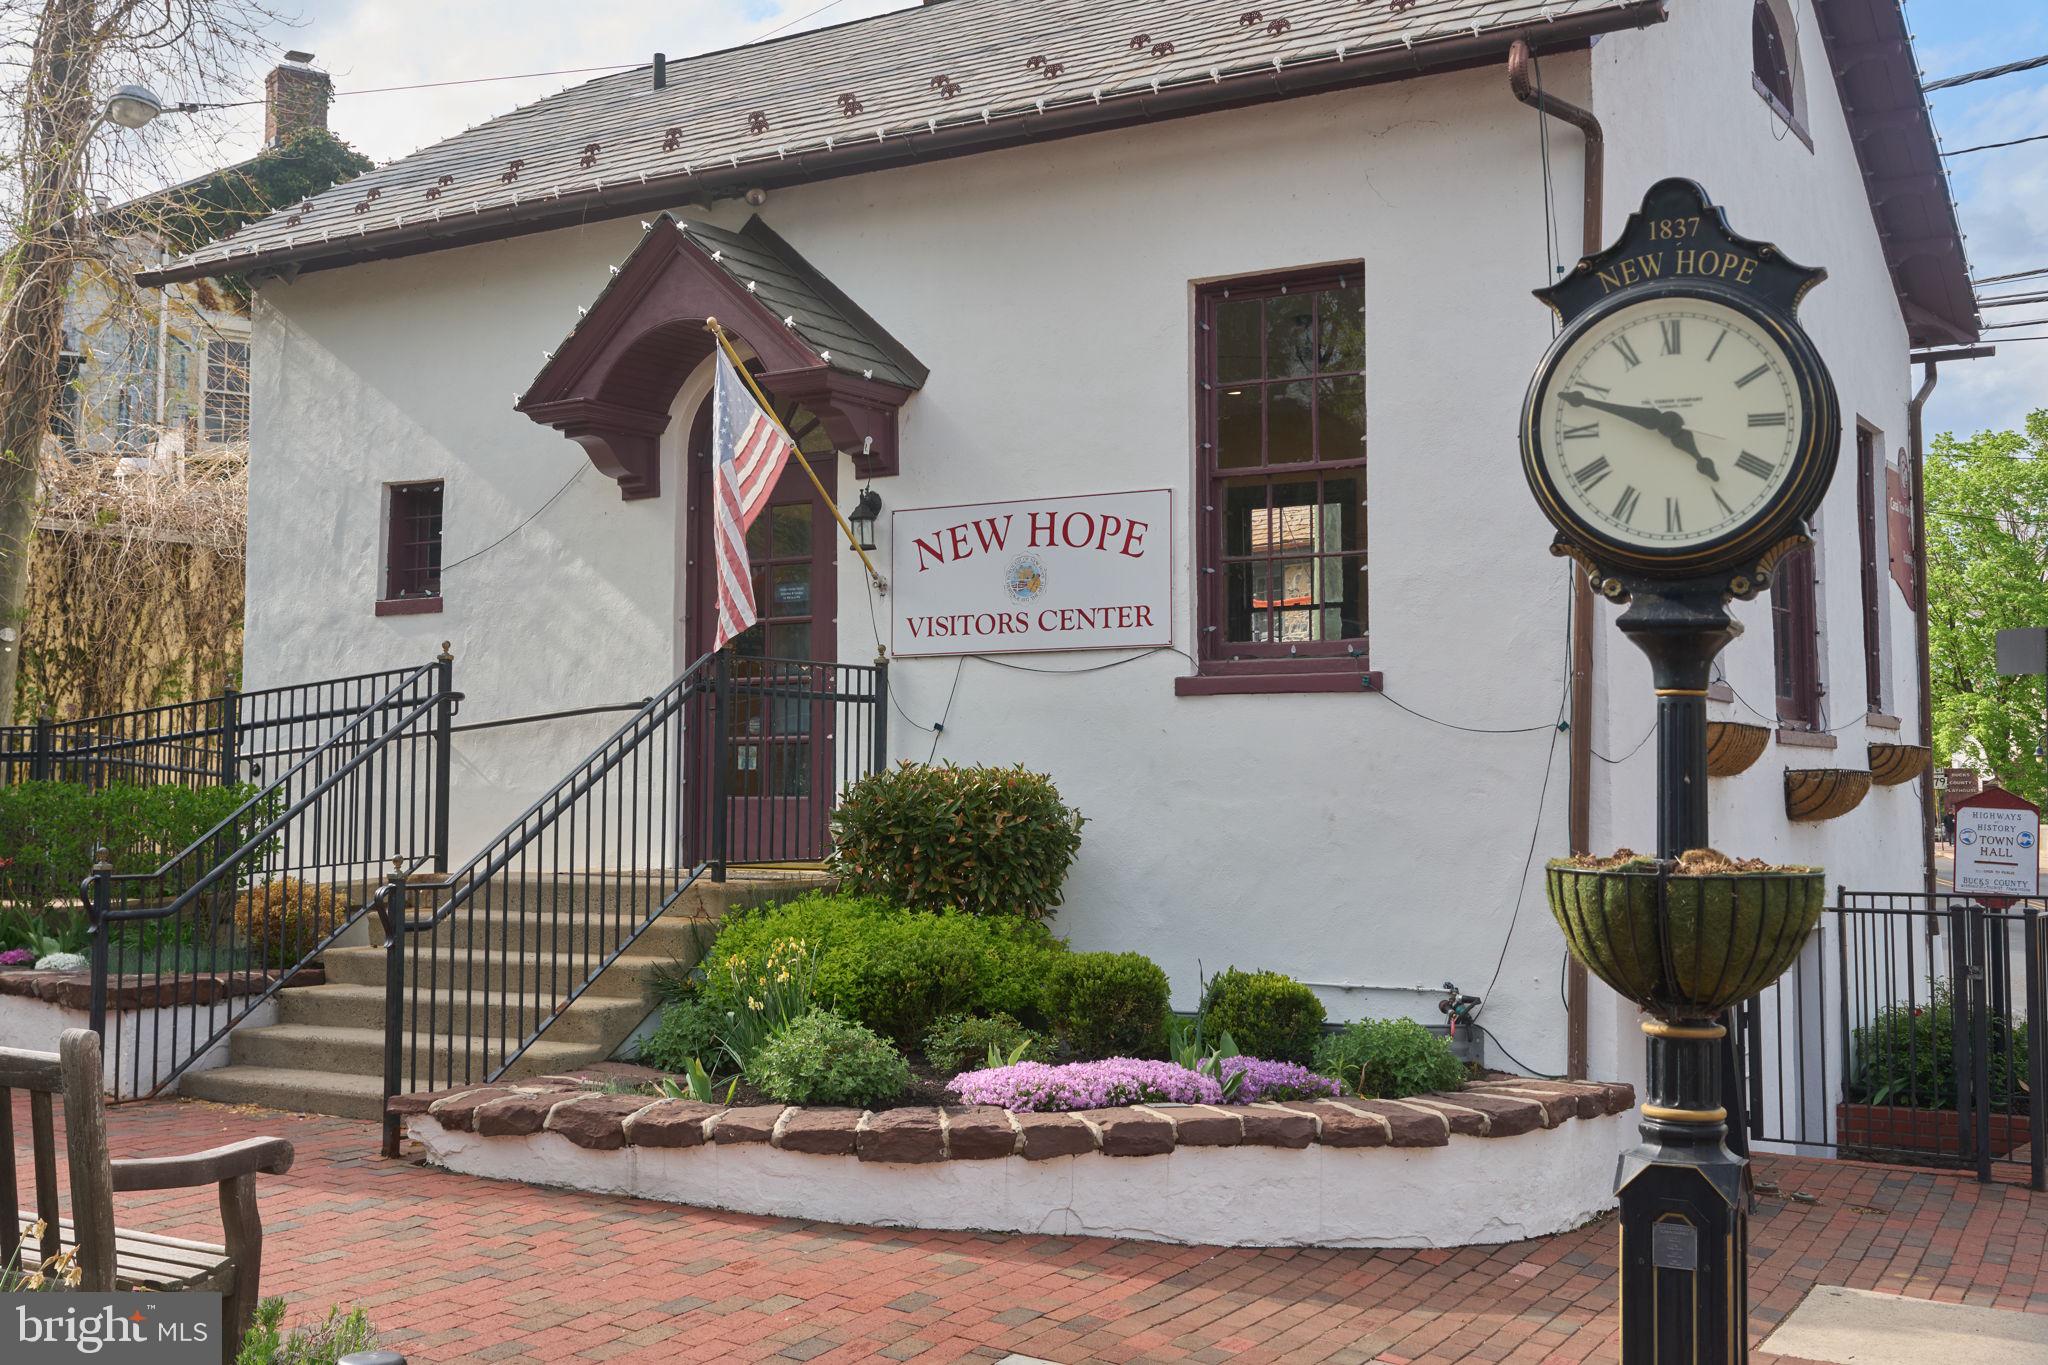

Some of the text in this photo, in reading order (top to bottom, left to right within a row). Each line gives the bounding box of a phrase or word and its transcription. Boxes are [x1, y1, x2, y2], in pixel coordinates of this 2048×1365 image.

[1650, 217, 1700, 241] 1837
[1596, 249, 1759, 294] NEW HOPE
[1660, 319, 1682, 356] XII
[912, 511, 1149, 573] NEW HOPE
[906, 604, 1155, 639] VISITORS CENTER
[1972, 811, 2022, 821] HIGHWAYS
[1977, 824, 2017, 833] HISTORY
[1979, 835, 2014, 846] TOWN
[1980, 846, 2013, 857] HALL
[1963, 876, 1990, 886] BUCKS
[1993, 878, 2029, 888] COUNTY
